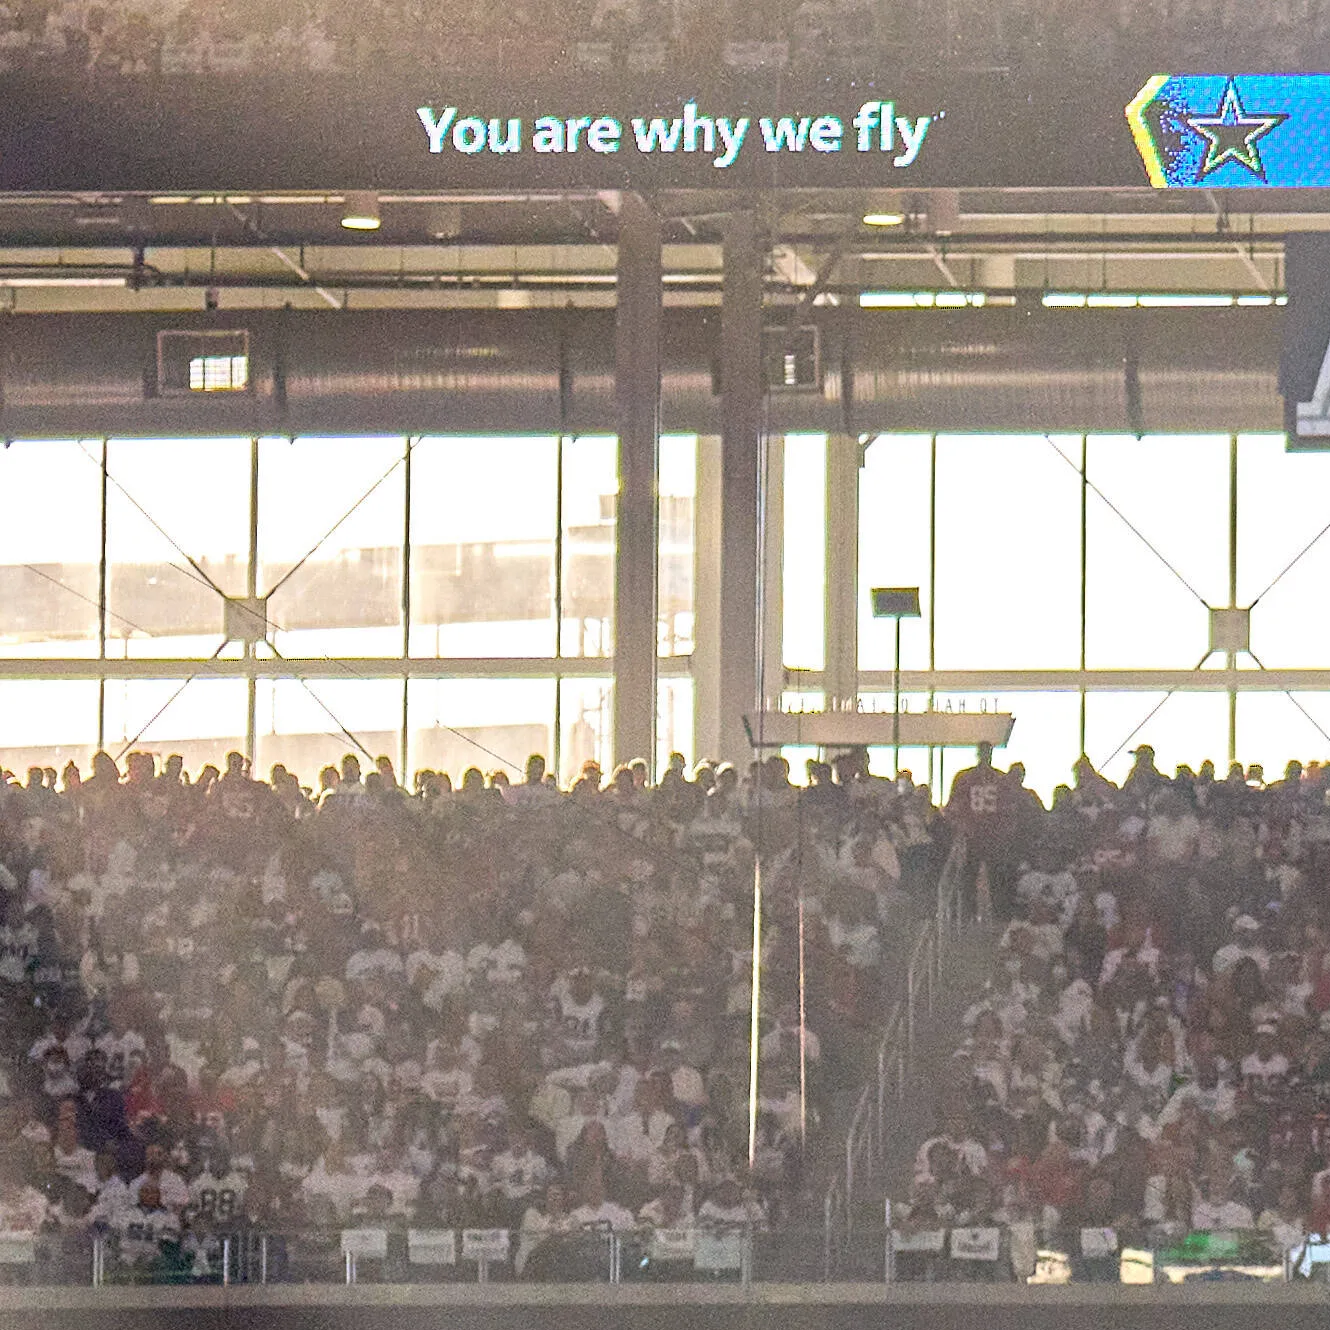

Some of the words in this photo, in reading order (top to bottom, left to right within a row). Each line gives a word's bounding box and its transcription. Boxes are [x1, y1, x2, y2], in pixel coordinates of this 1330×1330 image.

[417, 107, 521, 154] You
[533, 116, 621, 154] are
[632, 102, 749, 168] why
[758, 116, 843, 154] we
[852, 101, 931, 168] fly
[201, 1189, 234, 1217] 88
